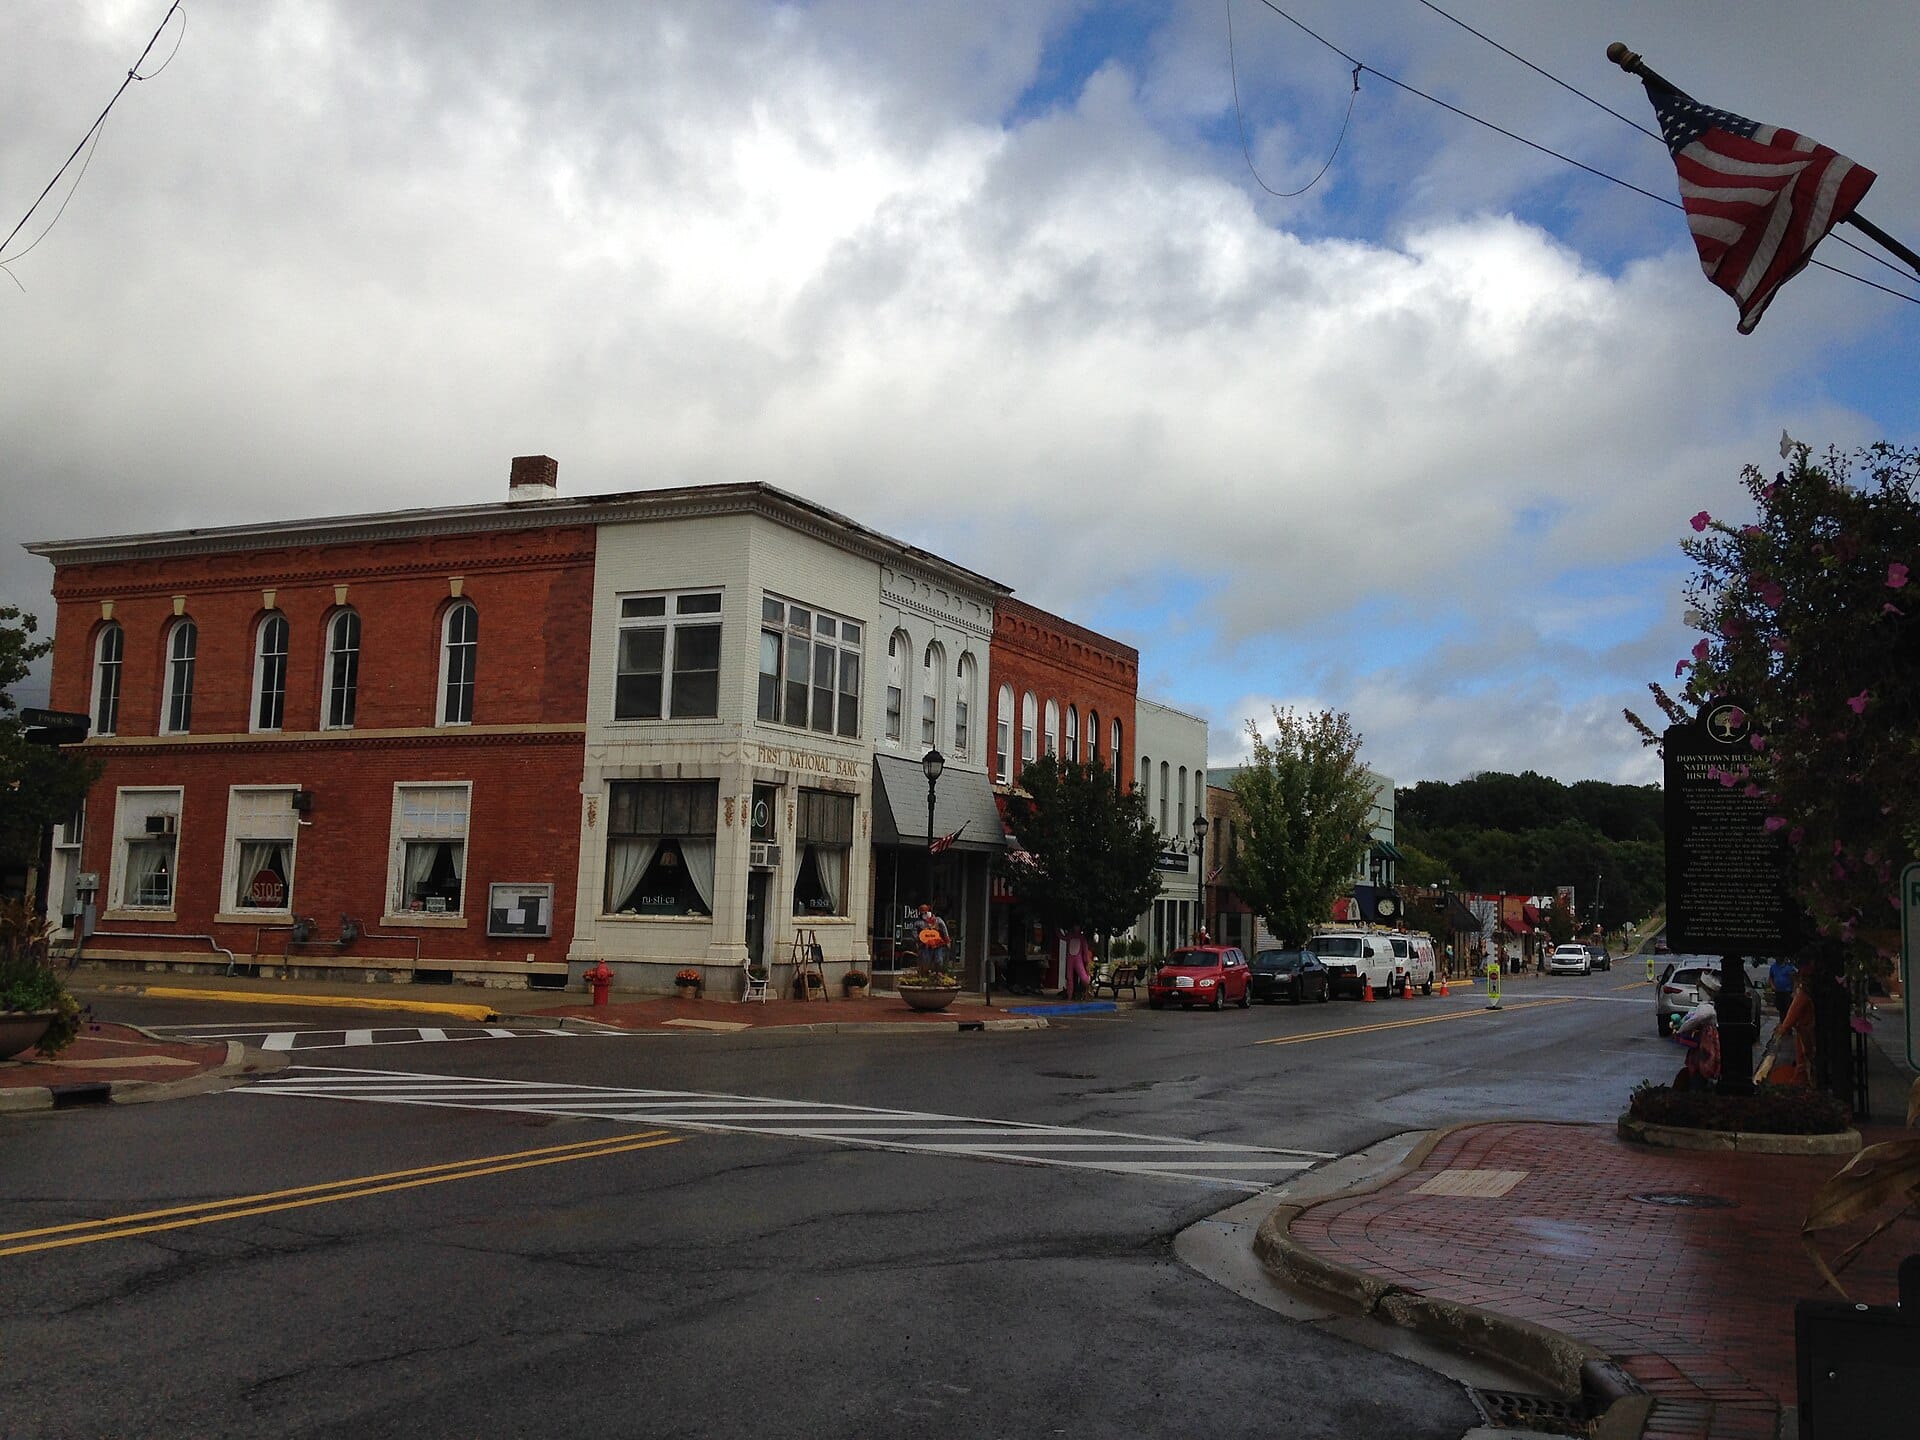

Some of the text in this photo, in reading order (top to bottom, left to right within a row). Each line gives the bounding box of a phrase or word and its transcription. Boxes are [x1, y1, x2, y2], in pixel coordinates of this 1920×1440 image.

[757, 746, 859, 777] FIRST NATIONAL BANK
[1676, 754, 1730, 763] DOWNTOWN
[253, 882, 281, 897] STOP
